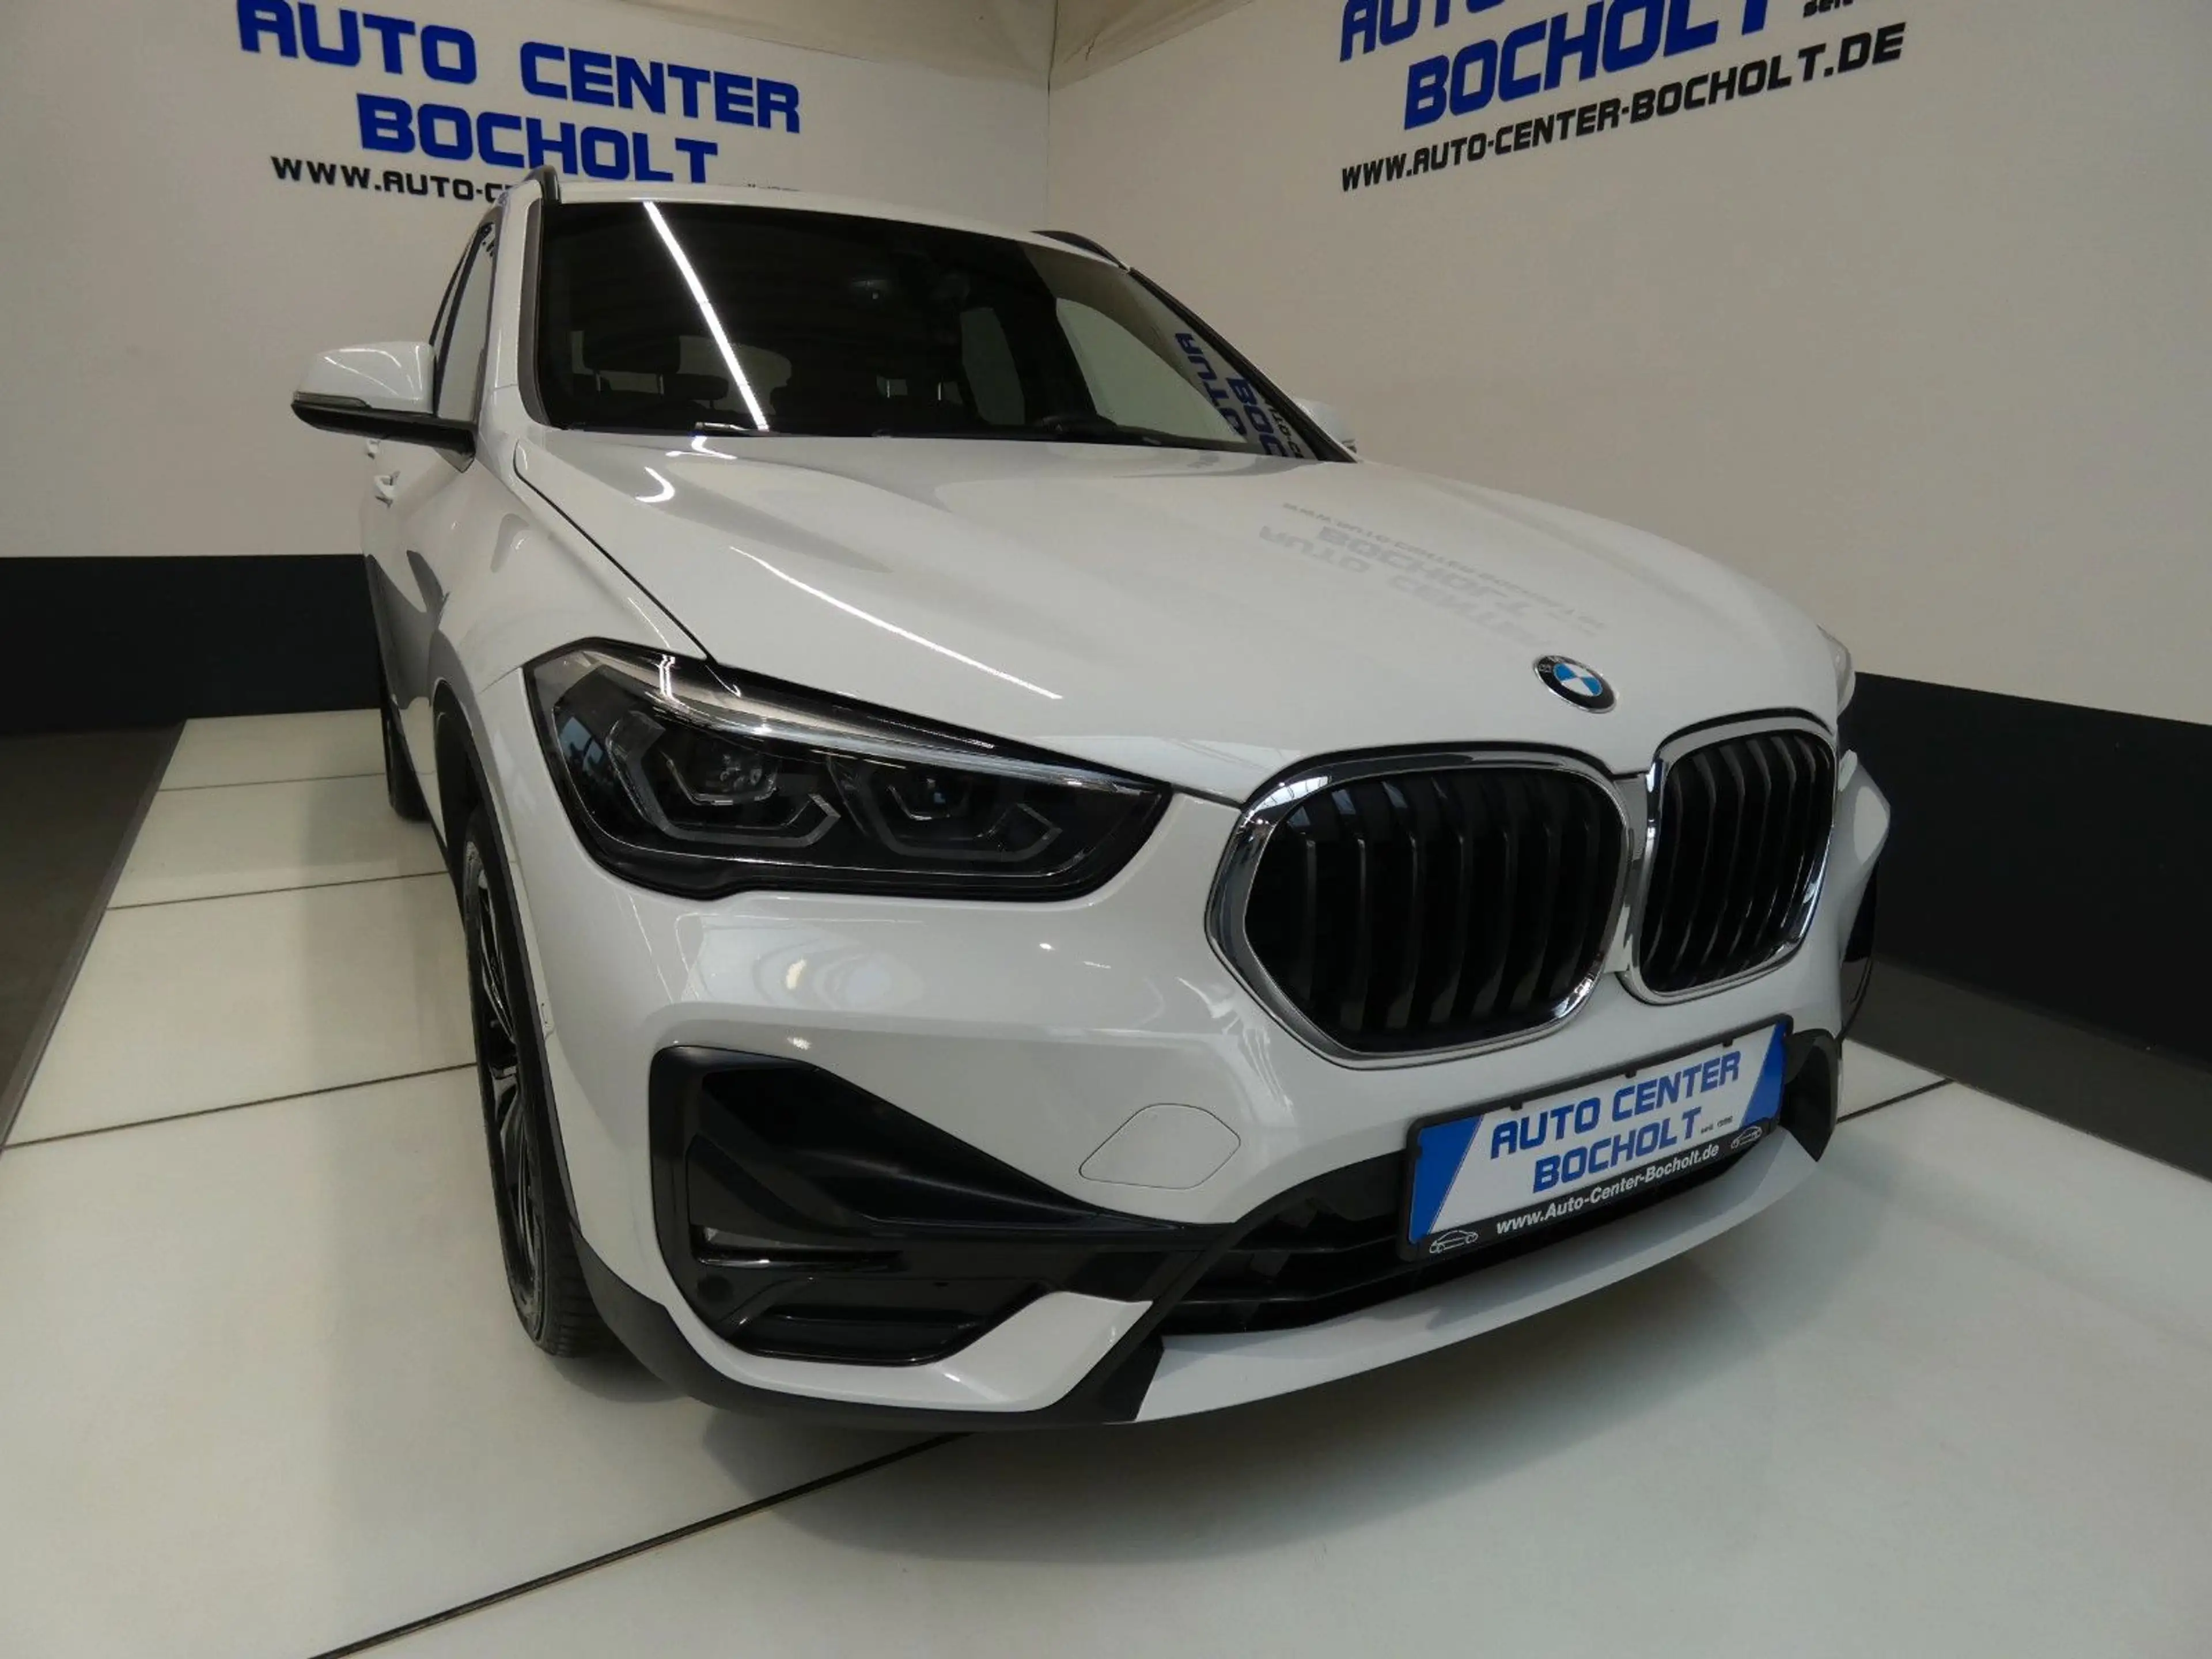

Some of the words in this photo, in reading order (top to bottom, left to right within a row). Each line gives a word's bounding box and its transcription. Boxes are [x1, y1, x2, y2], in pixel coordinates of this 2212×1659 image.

[236, 0, 478, 85] AUTO
[521, 41, 800, 133] CENTER
[1341, 22, 1906, 192] WWW.AUTO-CENTER-BOCHOLT.DE
[270, 156, 512, 203] WWW.AUTO-C
[357, 93, 718, 183] BOCHOLT
[1490, 1097, 1601, 1160] AUTO
[1612, 1050, 1741, 1123] CENTER
[1533, 1105, 1702, 1194] BOCHOLT
[1497, 1144, 1719, 1234] www.Auto-Center-Bocholt.de
